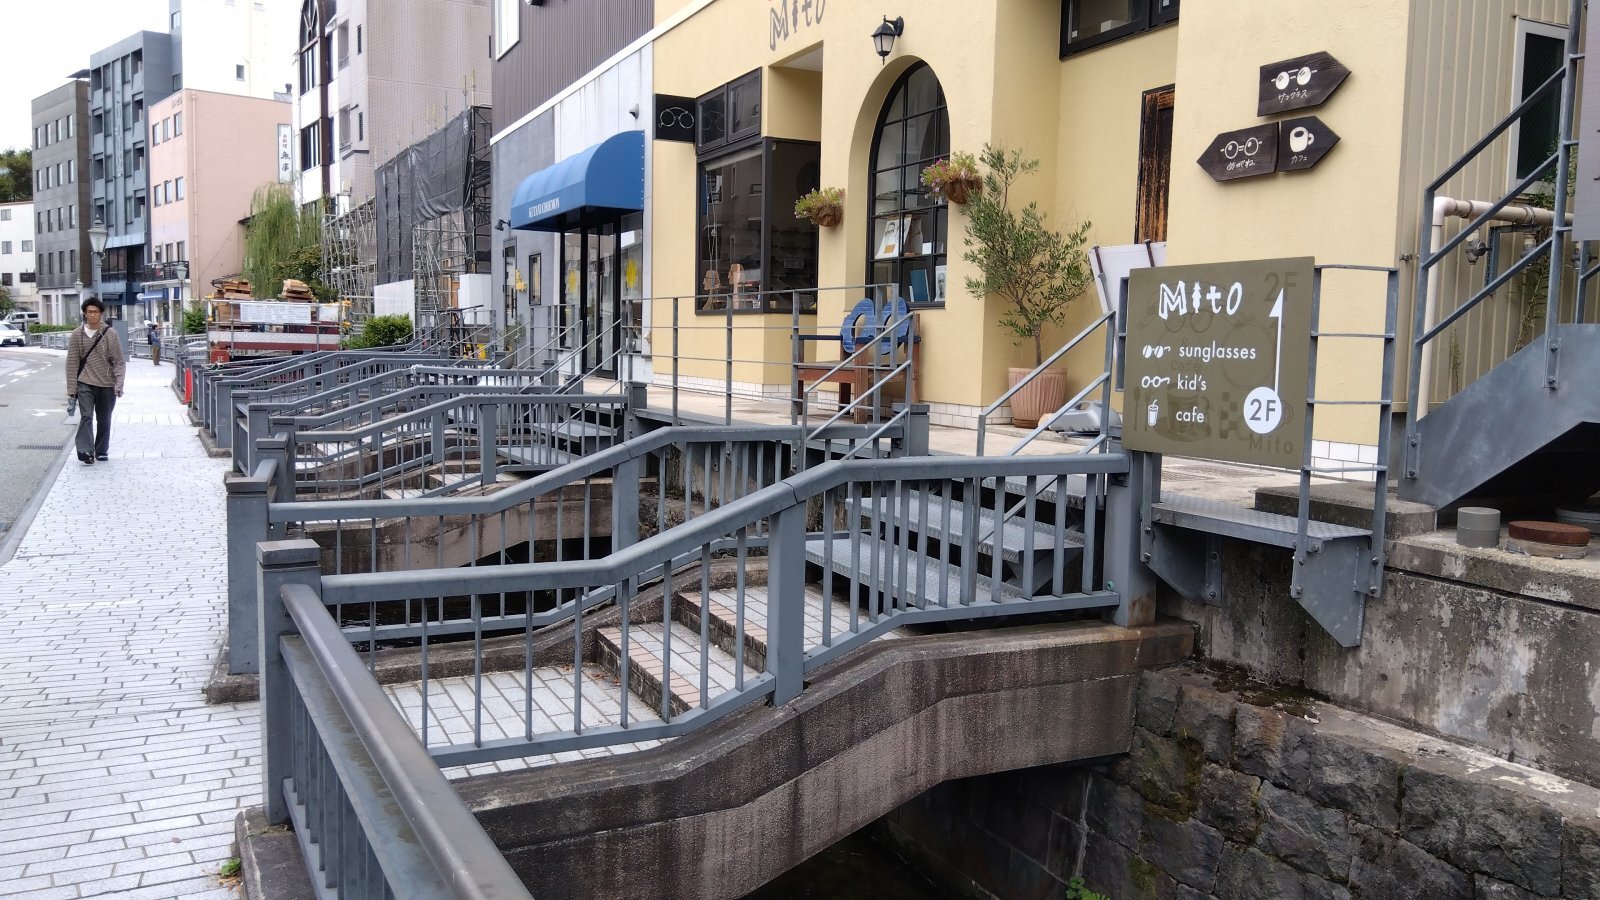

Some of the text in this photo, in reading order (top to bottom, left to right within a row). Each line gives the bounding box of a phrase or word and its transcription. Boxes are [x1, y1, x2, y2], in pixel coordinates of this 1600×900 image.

[1278, 88, 1307, 103] サングラス
[1227, 159, 1255, 171] めがね
[1291, 154, 1308, 165] カフェ
[1179, 340, 1257, 363] sunglasses
[1177, 373, 1207, 391] kid's
[1175, 406, 1205, 423] cafe
[1249, 398, 1277, 422] 2F
